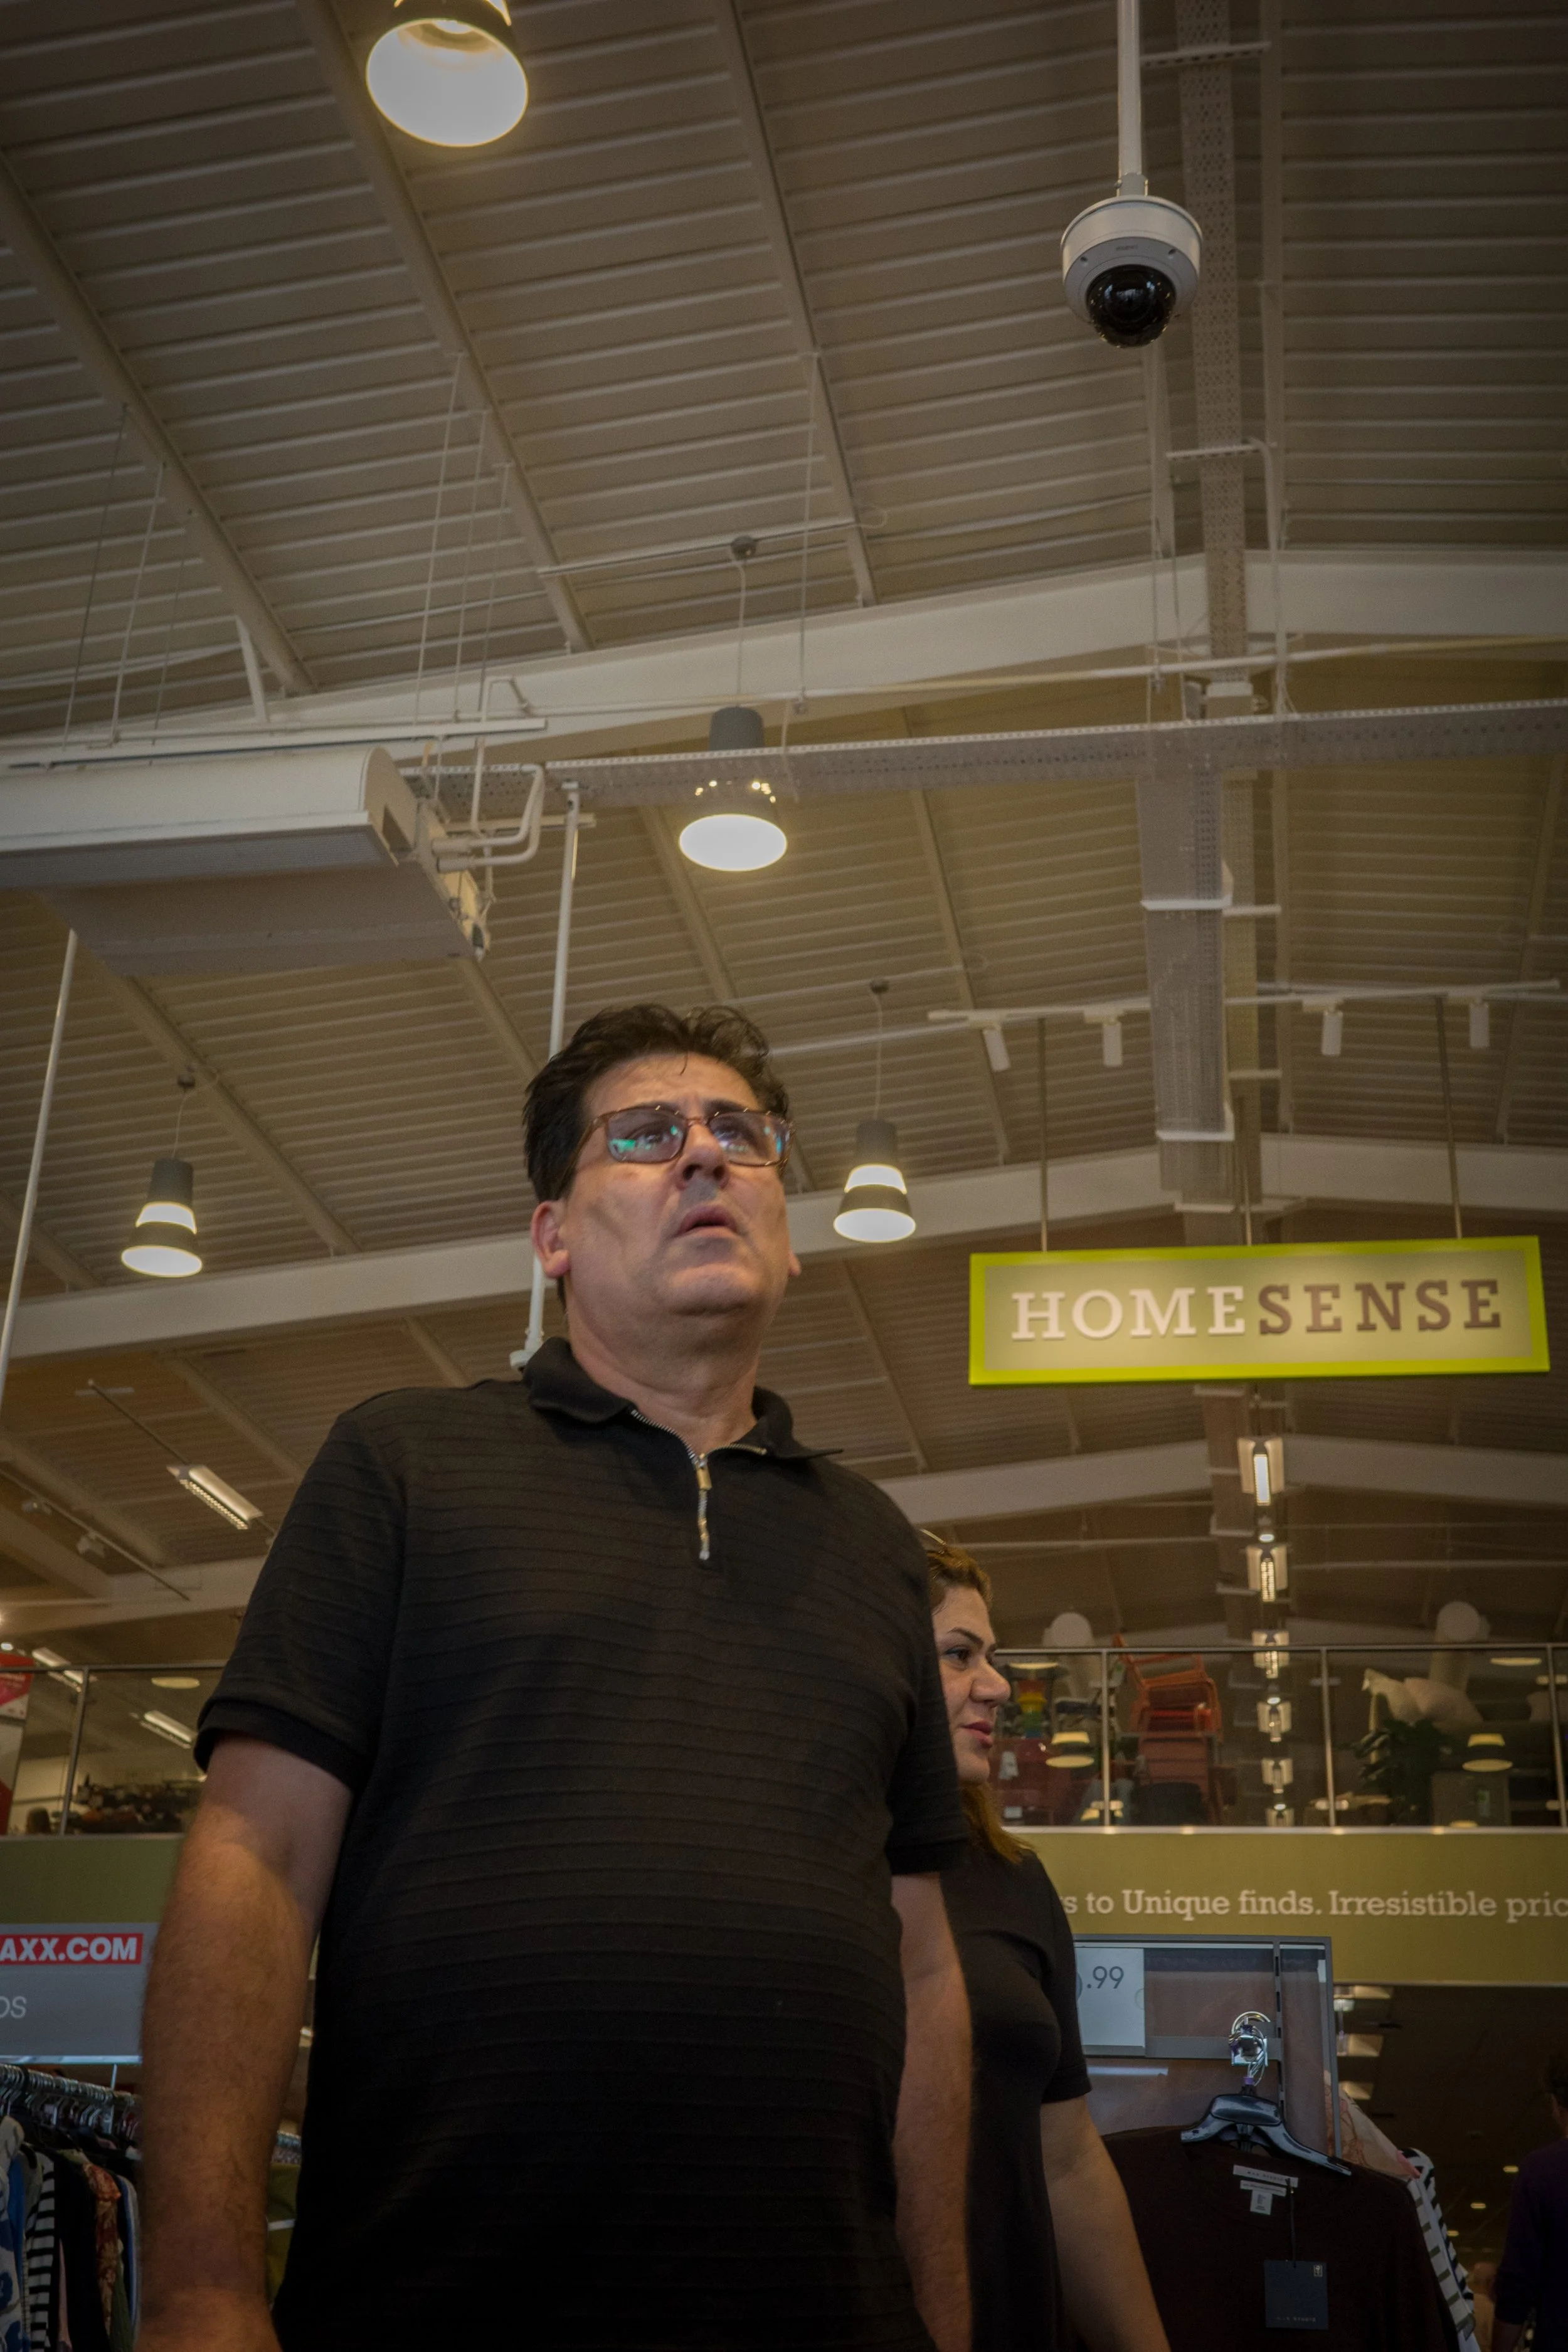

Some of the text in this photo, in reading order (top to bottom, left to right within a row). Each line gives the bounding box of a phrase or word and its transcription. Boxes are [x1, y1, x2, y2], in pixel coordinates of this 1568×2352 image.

[1011, 1279, 1502, 1341] HOMESENSE
[1086, 1892, 1114, 1914] to
[1121, 1889, 1230, 1921] Unique
[1239, 1890, 1322, 1915] finds.
[1328, 1890, 1498, 1917] Irresistible
